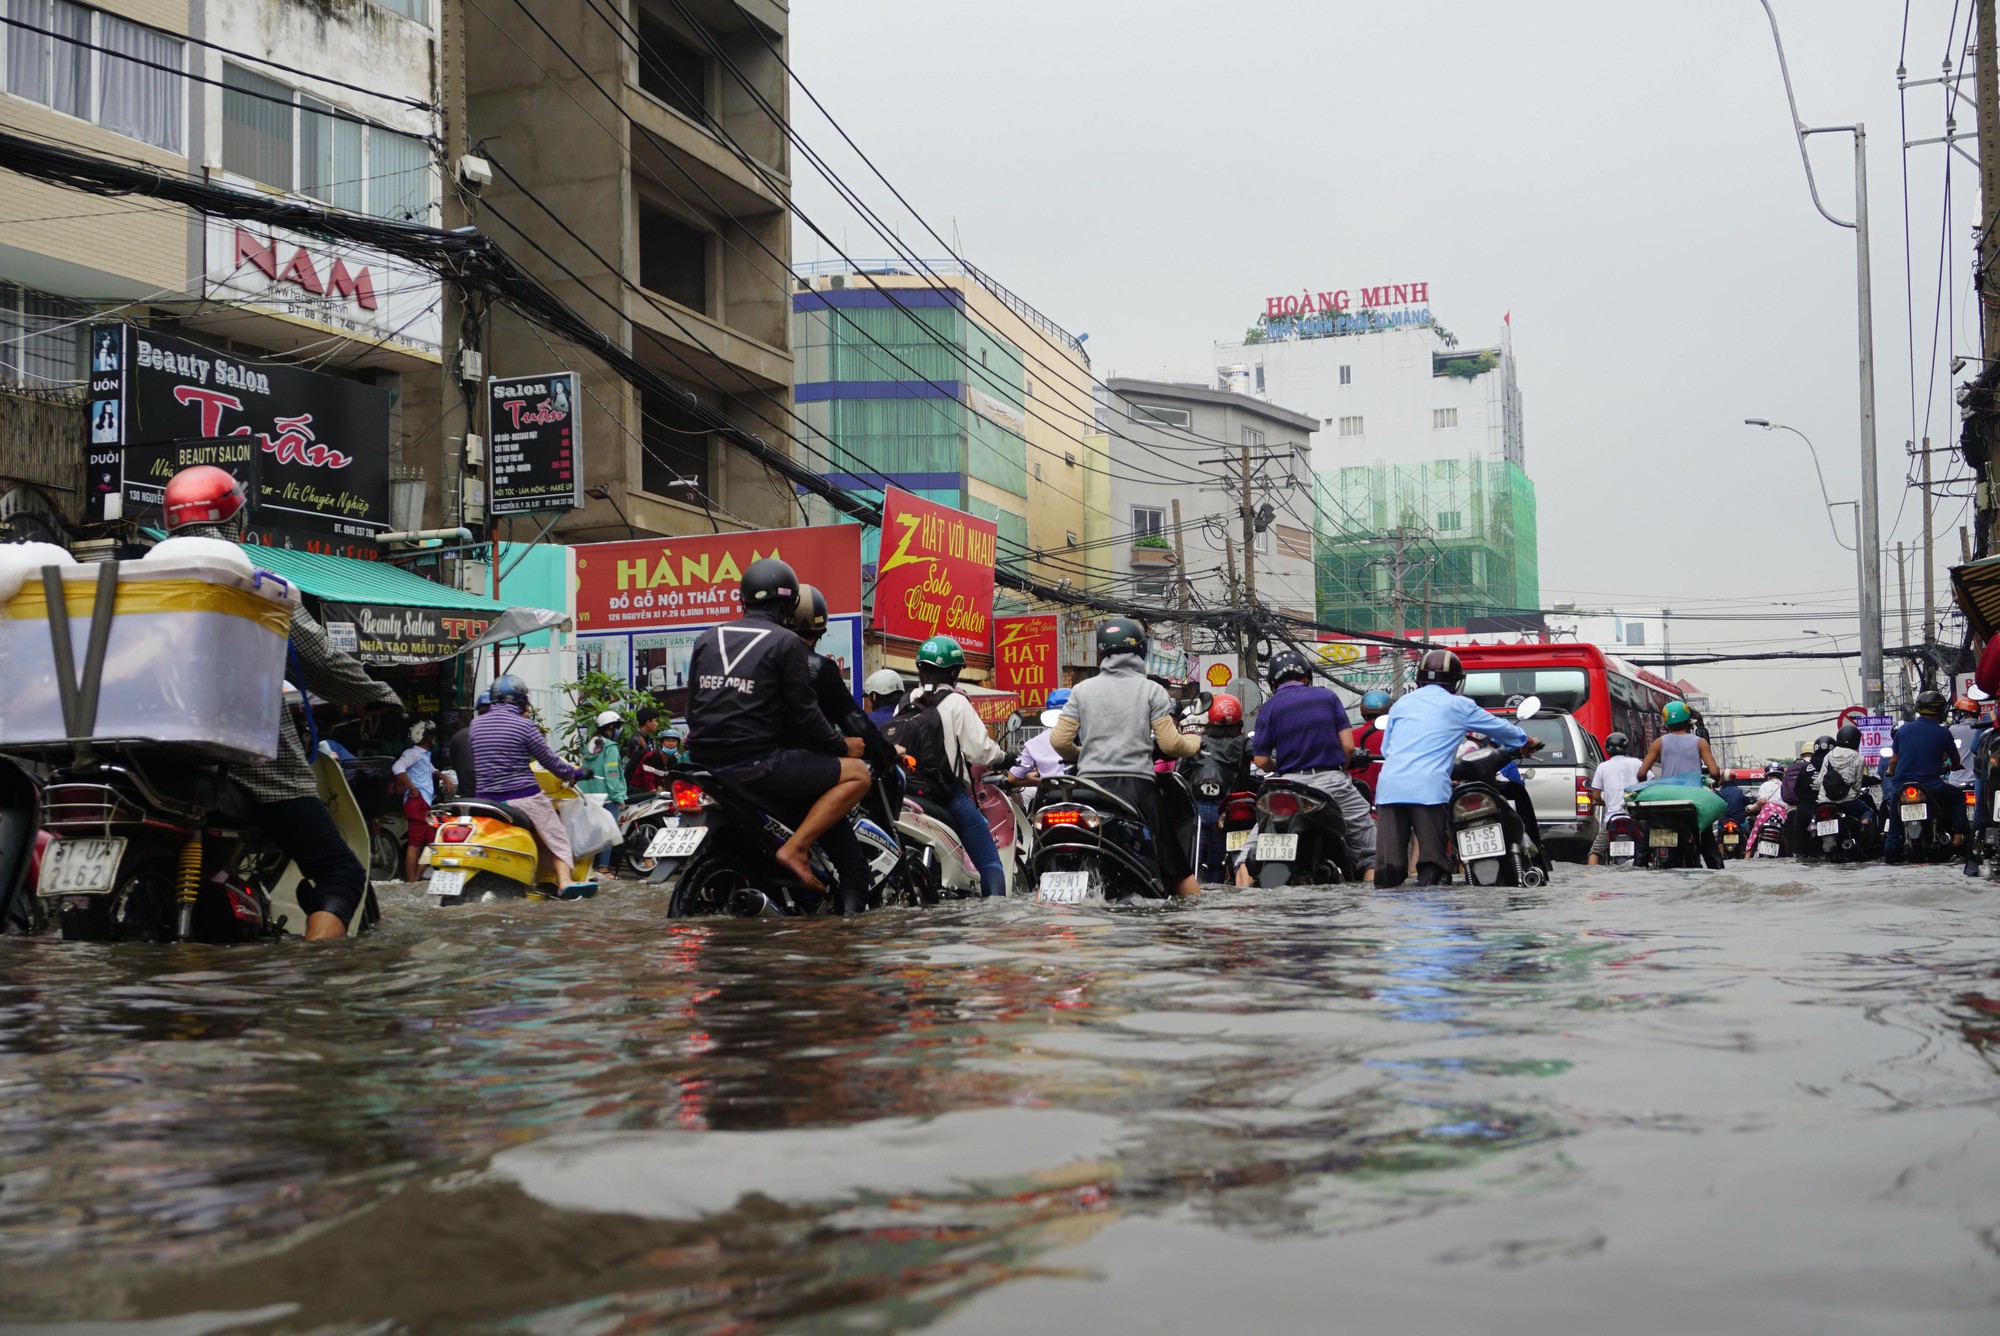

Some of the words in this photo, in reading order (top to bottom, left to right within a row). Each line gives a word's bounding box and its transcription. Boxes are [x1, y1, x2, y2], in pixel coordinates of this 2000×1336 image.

[235, 226, 378, 312] NAM
[1266, 288, 1350, 317] HOÀNG
[1361, 282, 1429, 308] MINH
[137, 340, 210, 385] Beauty
[215, 358, 270, 395] Salon
[494, 383, 547, 399] Salon
[179, 448, 217, 466] BEAUTY
[219, 445, 250, 463] SALON
[129, 489, 140, 500] 130
[550, 483, 565, 492] MAKE
[566, 482, 573, 491] UP
[922, 511, 945, 553] HÁT
[967, 527, 995, 568] NHAU
[616, 547, 781, 591] HÀNA
[923, 563, 952, 597] Solo
[609, 592, 630, 610] ĐỒ
[658, 591, 684, 611] NỘI
[687, 586, 726, 606] THẤT
[622, 608, 652, 621] NGUYỄN
[705, 606, 730, 617] THẠNH
[946, 594, 985, 634] Bolero
[360, 608, 402, 641] Beauty
[402, 610, 436, 638] Salon
[360, 638, 384, 652] NHÀ
[384, 641, 408, 655] TẠO
[411, 638, 435, 654] MẪU
[1004, 643, 1049, 664] HÁT
[376, 654, 389, 662] 130
[1009, 664, 1044, 685] VỚI
[1861, 732, 1881, 747] 150
[662, 829, 698, 841] 79-H1
[858, 826, 890, 849] SUZUKI
[1263, 835, 1292, 847] 59-X2
[1464, 827, 1496, 843] 51-S5
[648, 842, 695, 855] 506.66
[1259, 847, 1294, 860] 101.38
[1466, 840, 1498, 855] 0305
[1047, 874, 1080, 889] 79-N1
